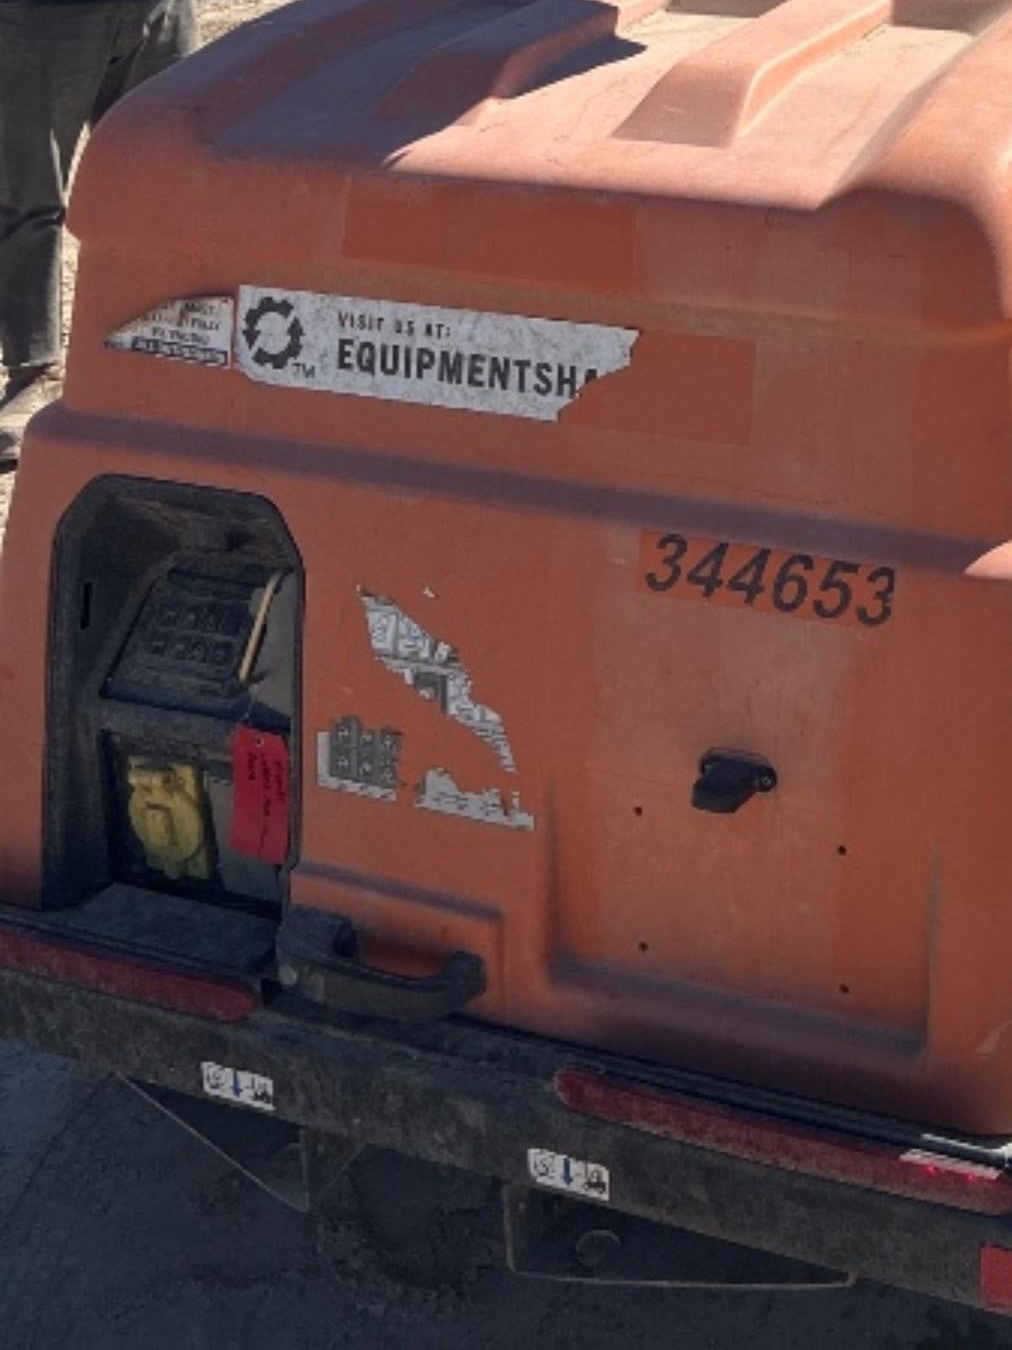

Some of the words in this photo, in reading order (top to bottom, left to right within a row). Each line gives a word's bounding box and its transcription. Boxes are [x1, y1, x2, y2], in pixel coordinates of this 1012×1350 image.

[337, 311, 384, 331] VISIT
[395, 321, 414, 337] US
[647, 533, 894, 626] 344653
